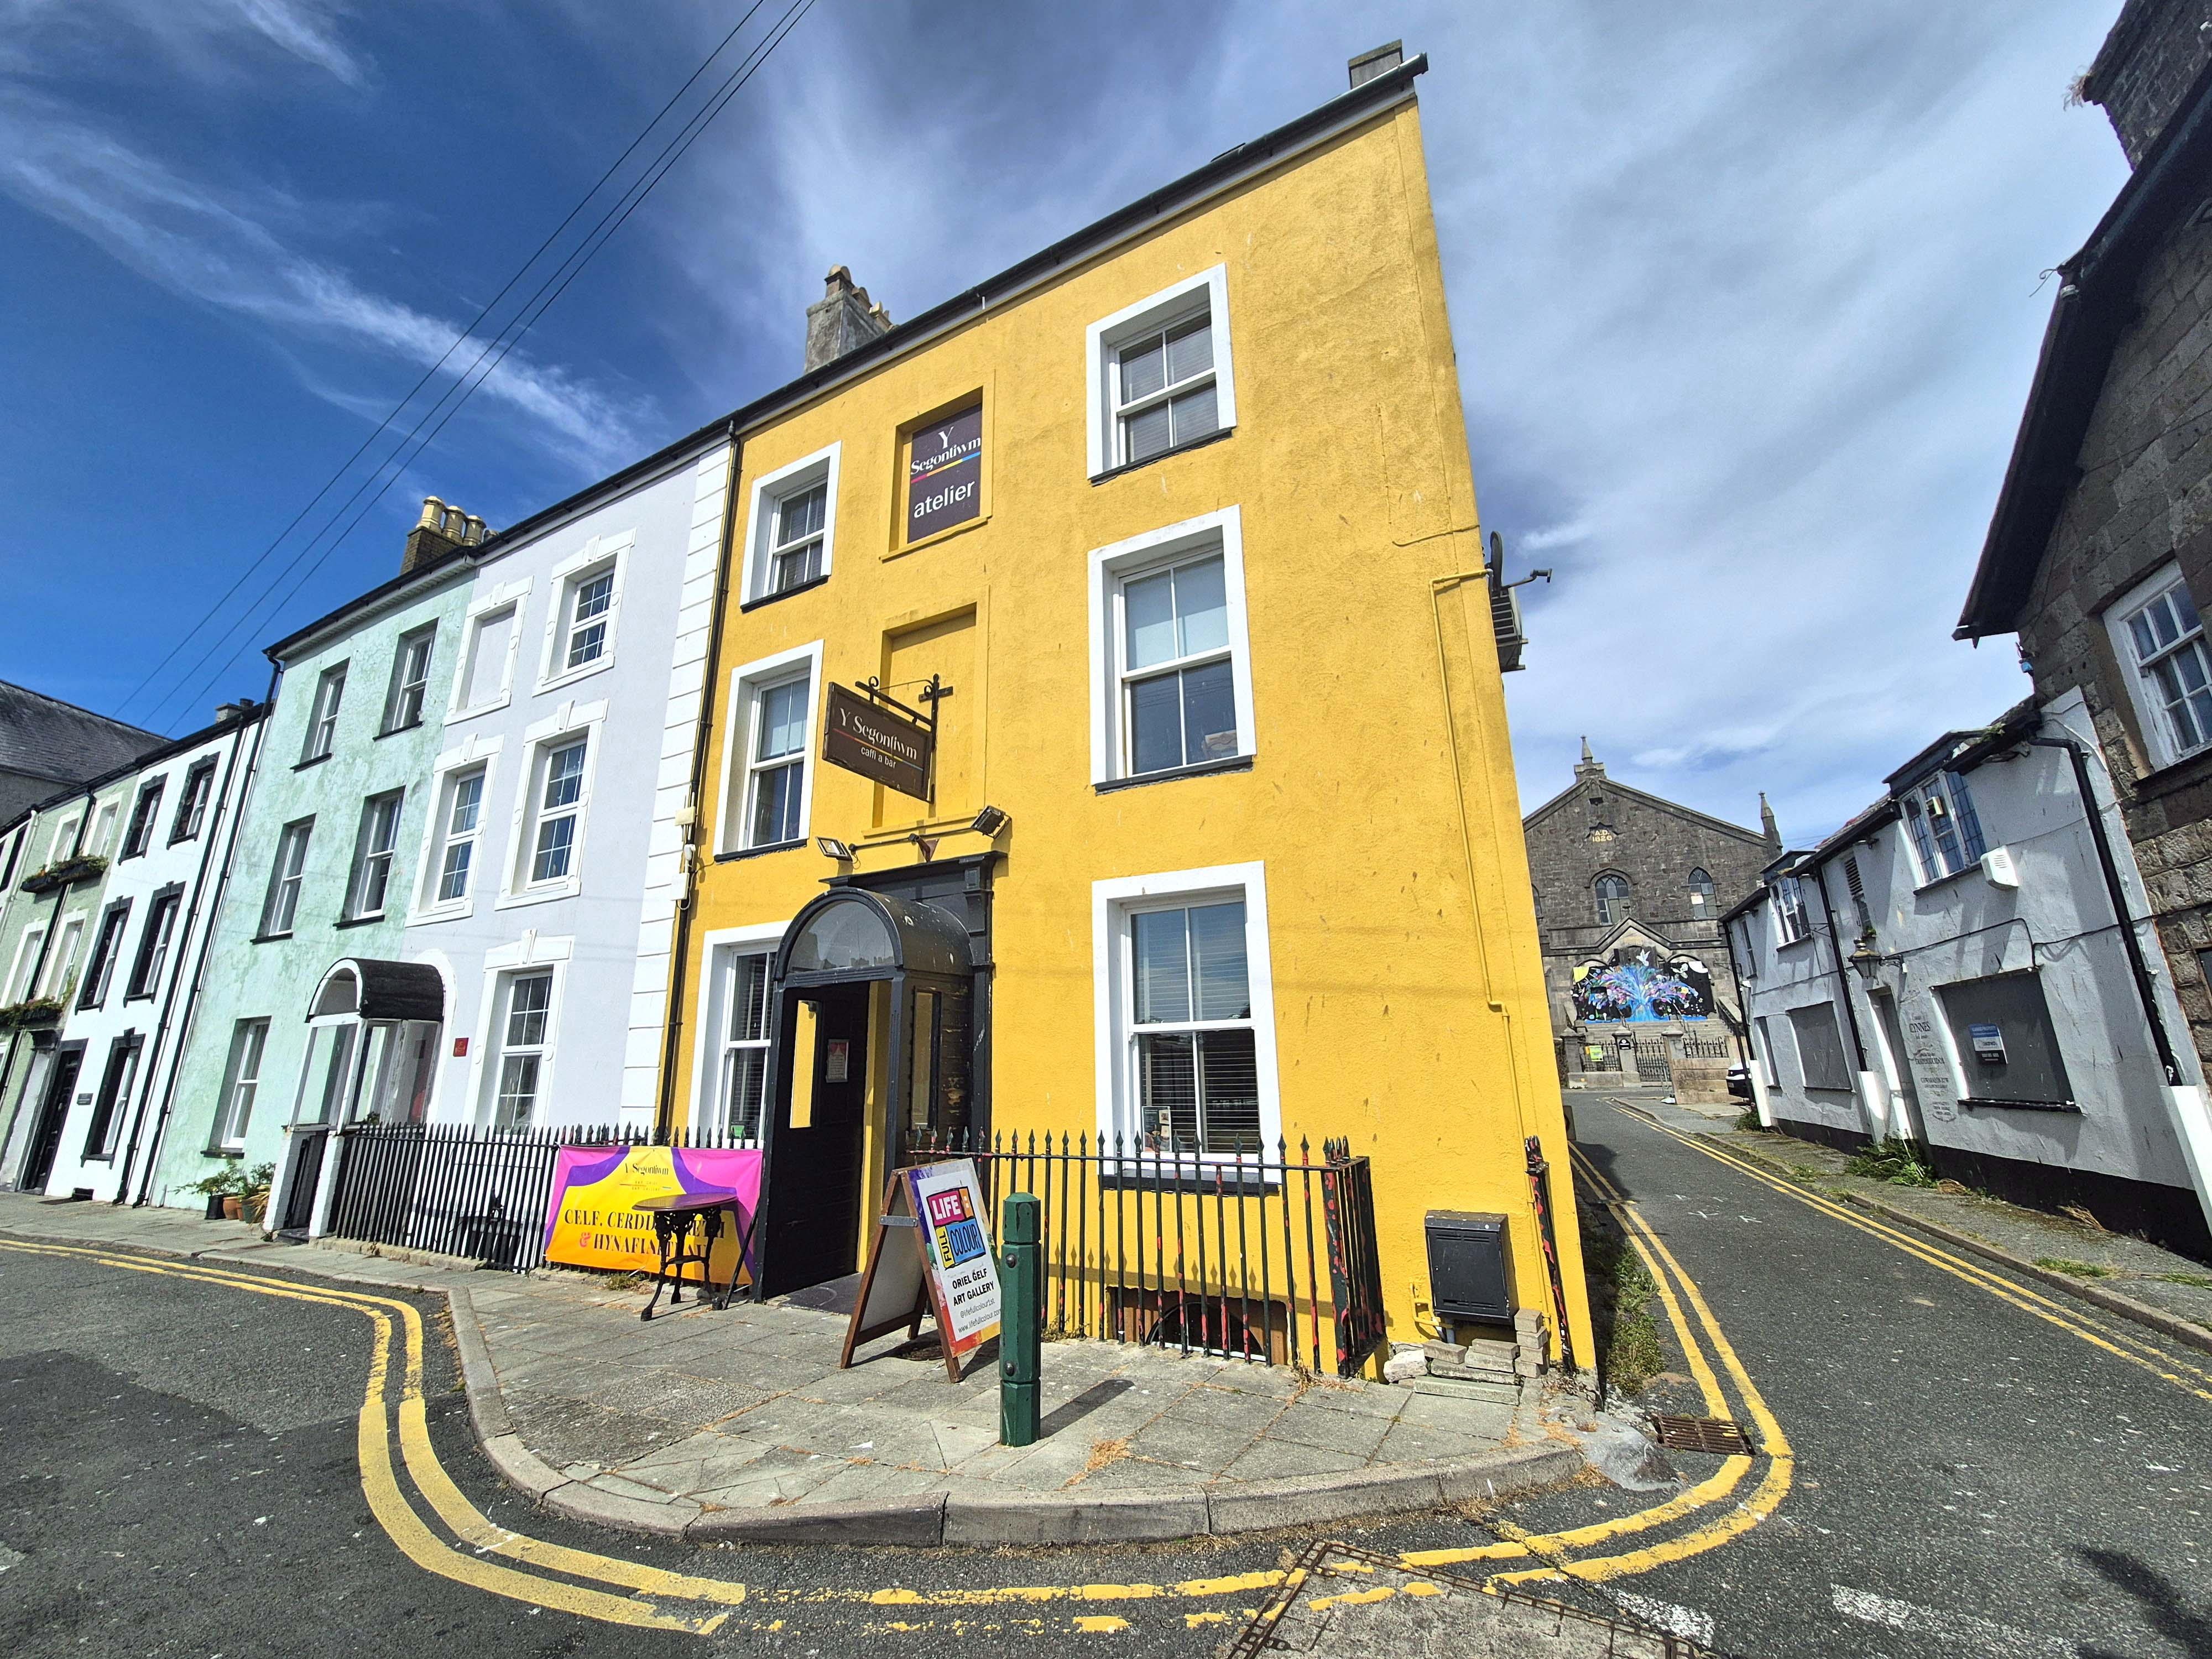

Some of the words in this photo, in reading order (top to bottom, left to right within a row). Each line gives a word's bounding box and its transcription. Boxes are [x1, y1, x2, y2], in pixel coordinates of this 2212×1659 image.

[938, 426, 954, 450] Y
[911, 437, 981, 474] Segontiwm
[914, 481, 975, 518] atelier
[840, 707, 851, 727] Y
[853, 716, 917, 760] Segontiwm
[860, 747, 877, 759] caffi
[878, 754, 883, 763] a
[885, 757, 896, 769] bar
[632, 1163, 669, 1176] Segontiwm
[580, 1232, 591, 1248] &
[940, 1230, 952, 1262] FULL
[950, 1224, 981, 1257] COLOUR
[952, 1275, 972, 1289] ORIEL
[972, 1268, 987, 1281] GELF
[953, 1293, 966, 1306] ART
[967, 1281, 994, 1300] GALLERY
[960, 1297, 995, 1318] @lifefullcolour1st
